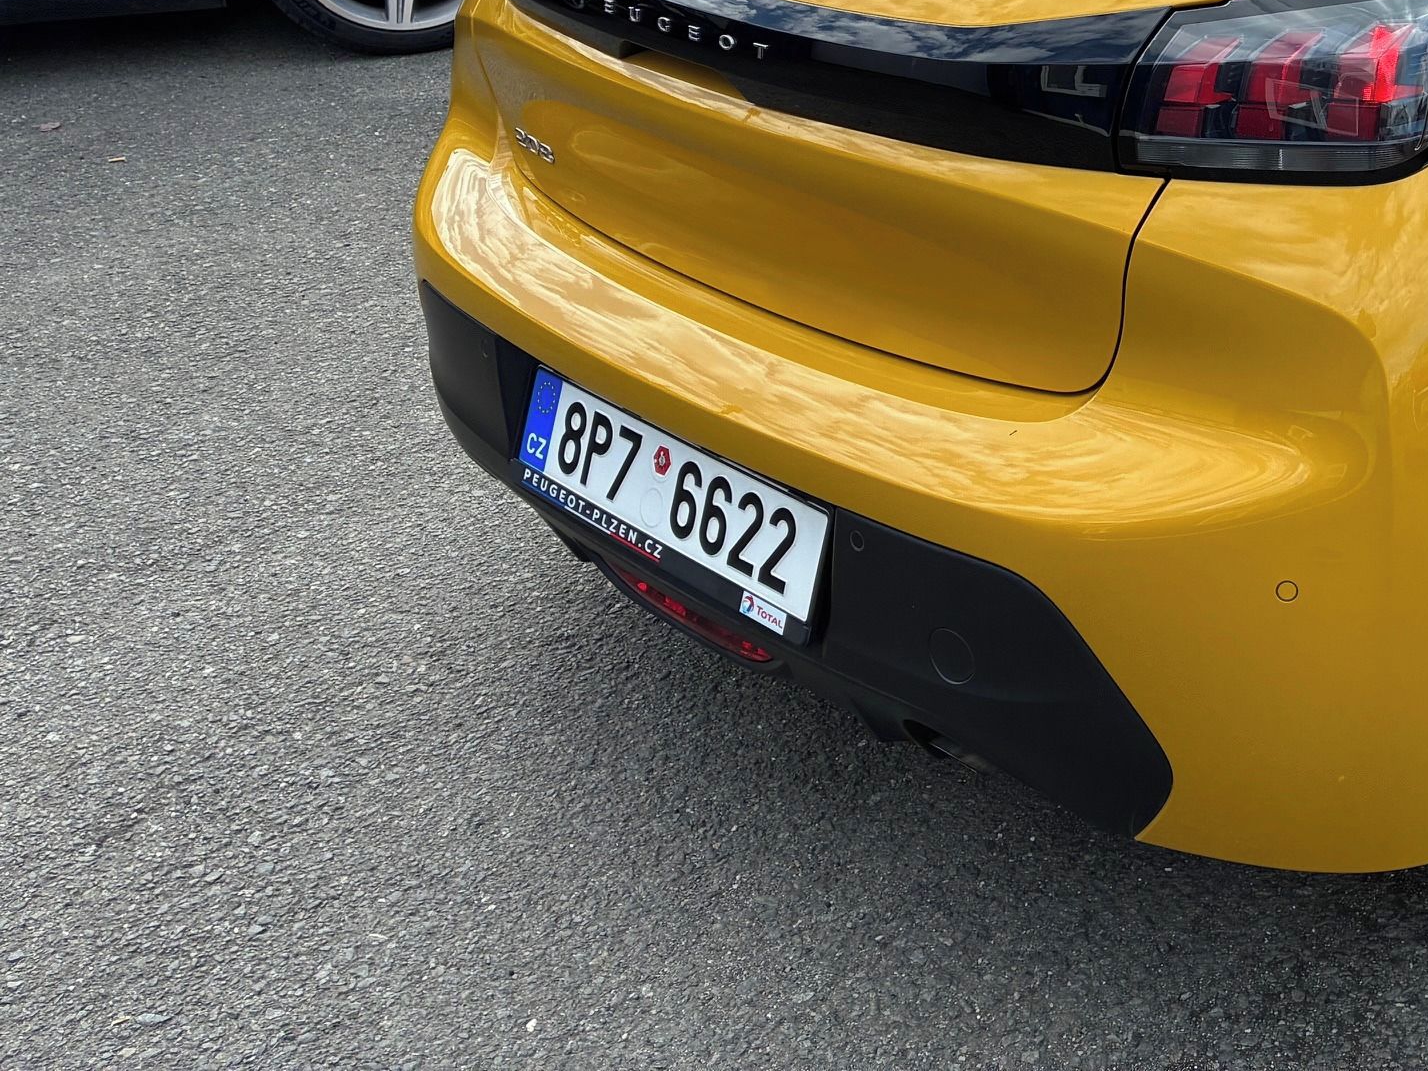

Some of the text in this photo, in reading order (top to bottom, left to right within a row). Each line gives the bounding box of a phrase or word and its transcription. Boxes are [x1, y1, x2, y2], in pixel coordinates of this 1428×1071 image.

[514, 127, 556, 164] 208
[526, 432, 548, 460] CZ
[522, 468, 664, 559] PEUGEOT-PLZEN.CZ
[557, 401, 797, 595] 8P7 6622
